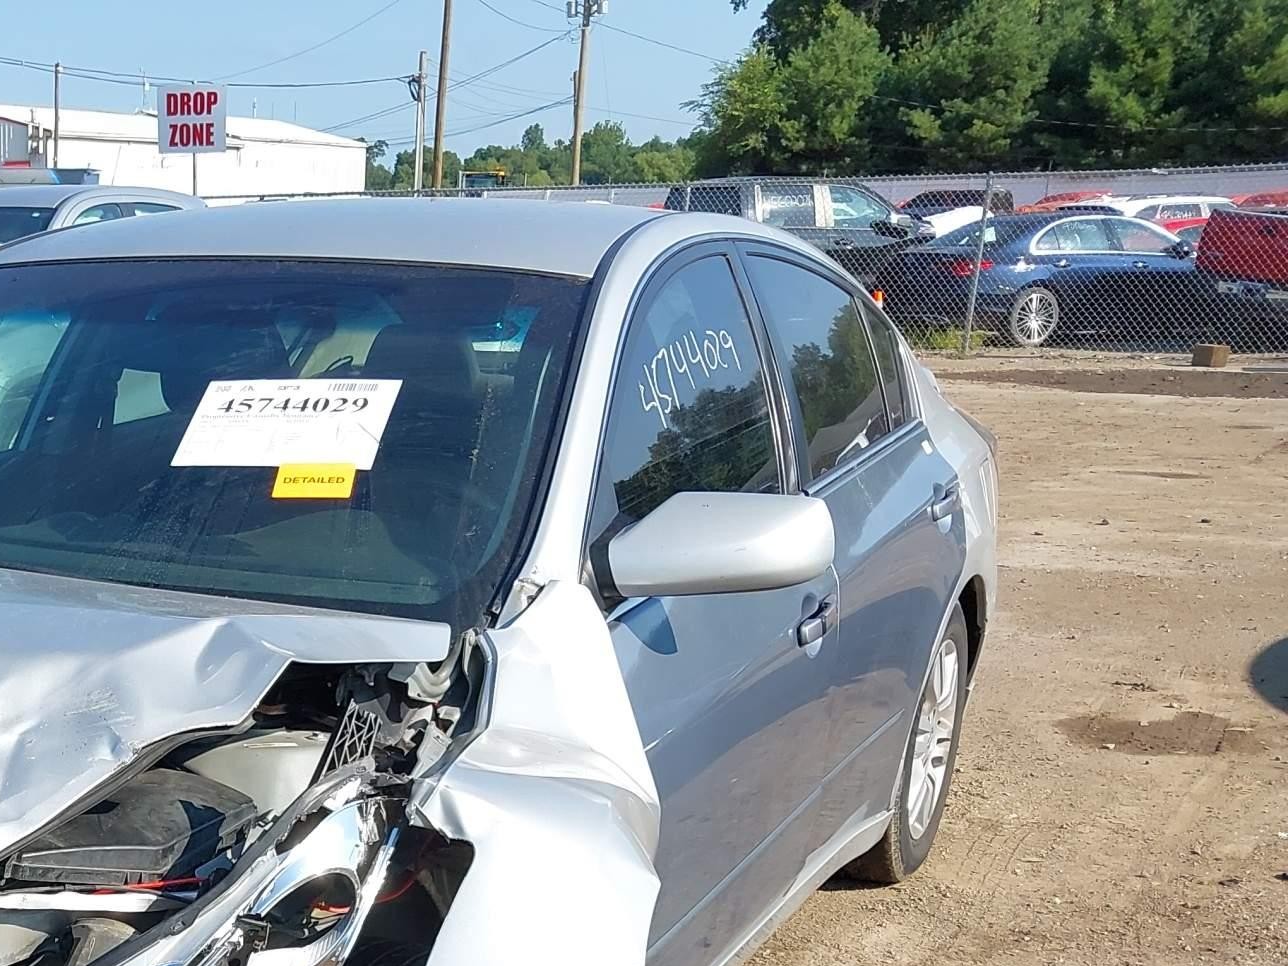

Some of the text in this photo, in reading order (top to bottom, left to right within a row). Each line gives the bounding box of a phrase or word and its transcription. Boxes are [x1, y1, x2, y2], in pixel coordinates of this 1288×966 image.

[166, 91, 218, 116] DROP
[169, 123, 215, 147] ZONE
[639, 330, 742, 429] 45744029
[217, 397, 369, 413] 45744029
[282, 476, 346, 485] DETAILED
